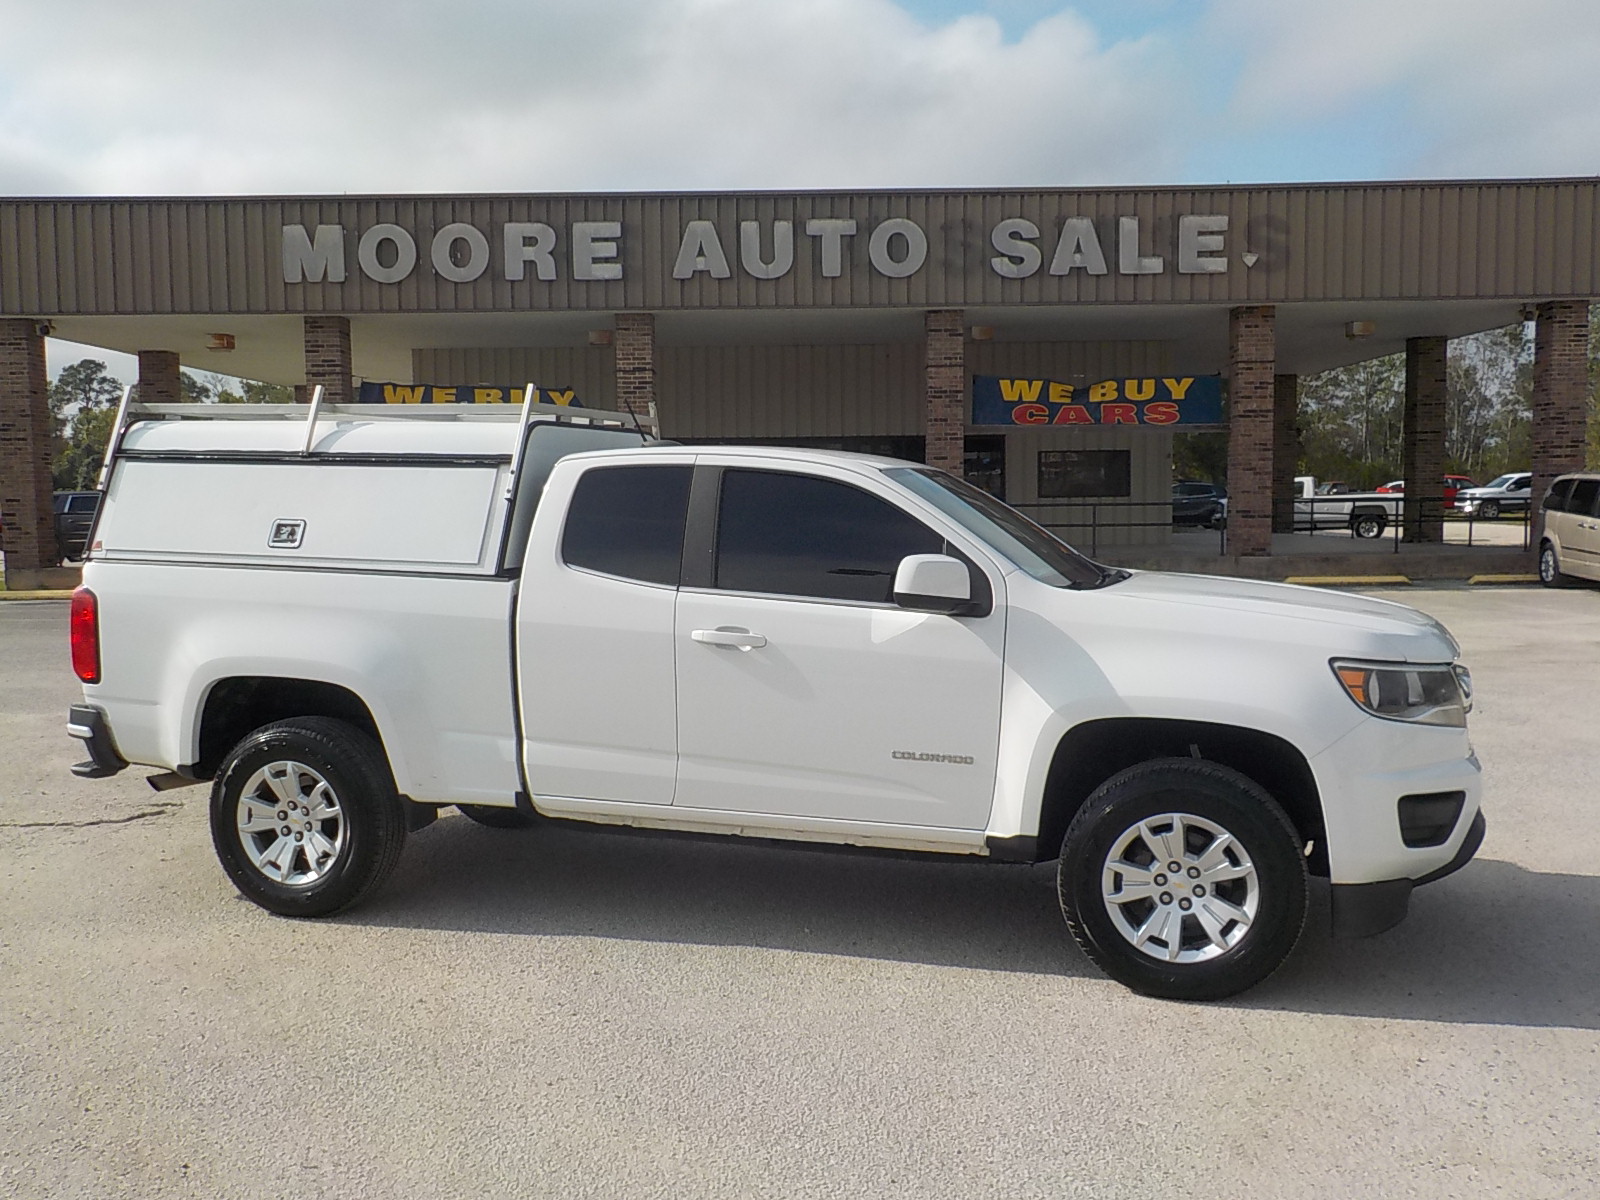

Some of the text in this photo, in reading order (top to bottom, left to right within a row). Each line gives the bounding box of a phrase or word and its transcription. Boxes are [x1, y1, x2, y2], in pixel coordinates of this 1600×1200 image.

[283, 214, 1259, 284] MOORE AUTO SALE
[383, 384, 458, 404] WE
[998, 377, 1195, 403] WE BUY
[1011, 401, 1181, 425] CARS
[891, 750, 974, 766] COLORADO
